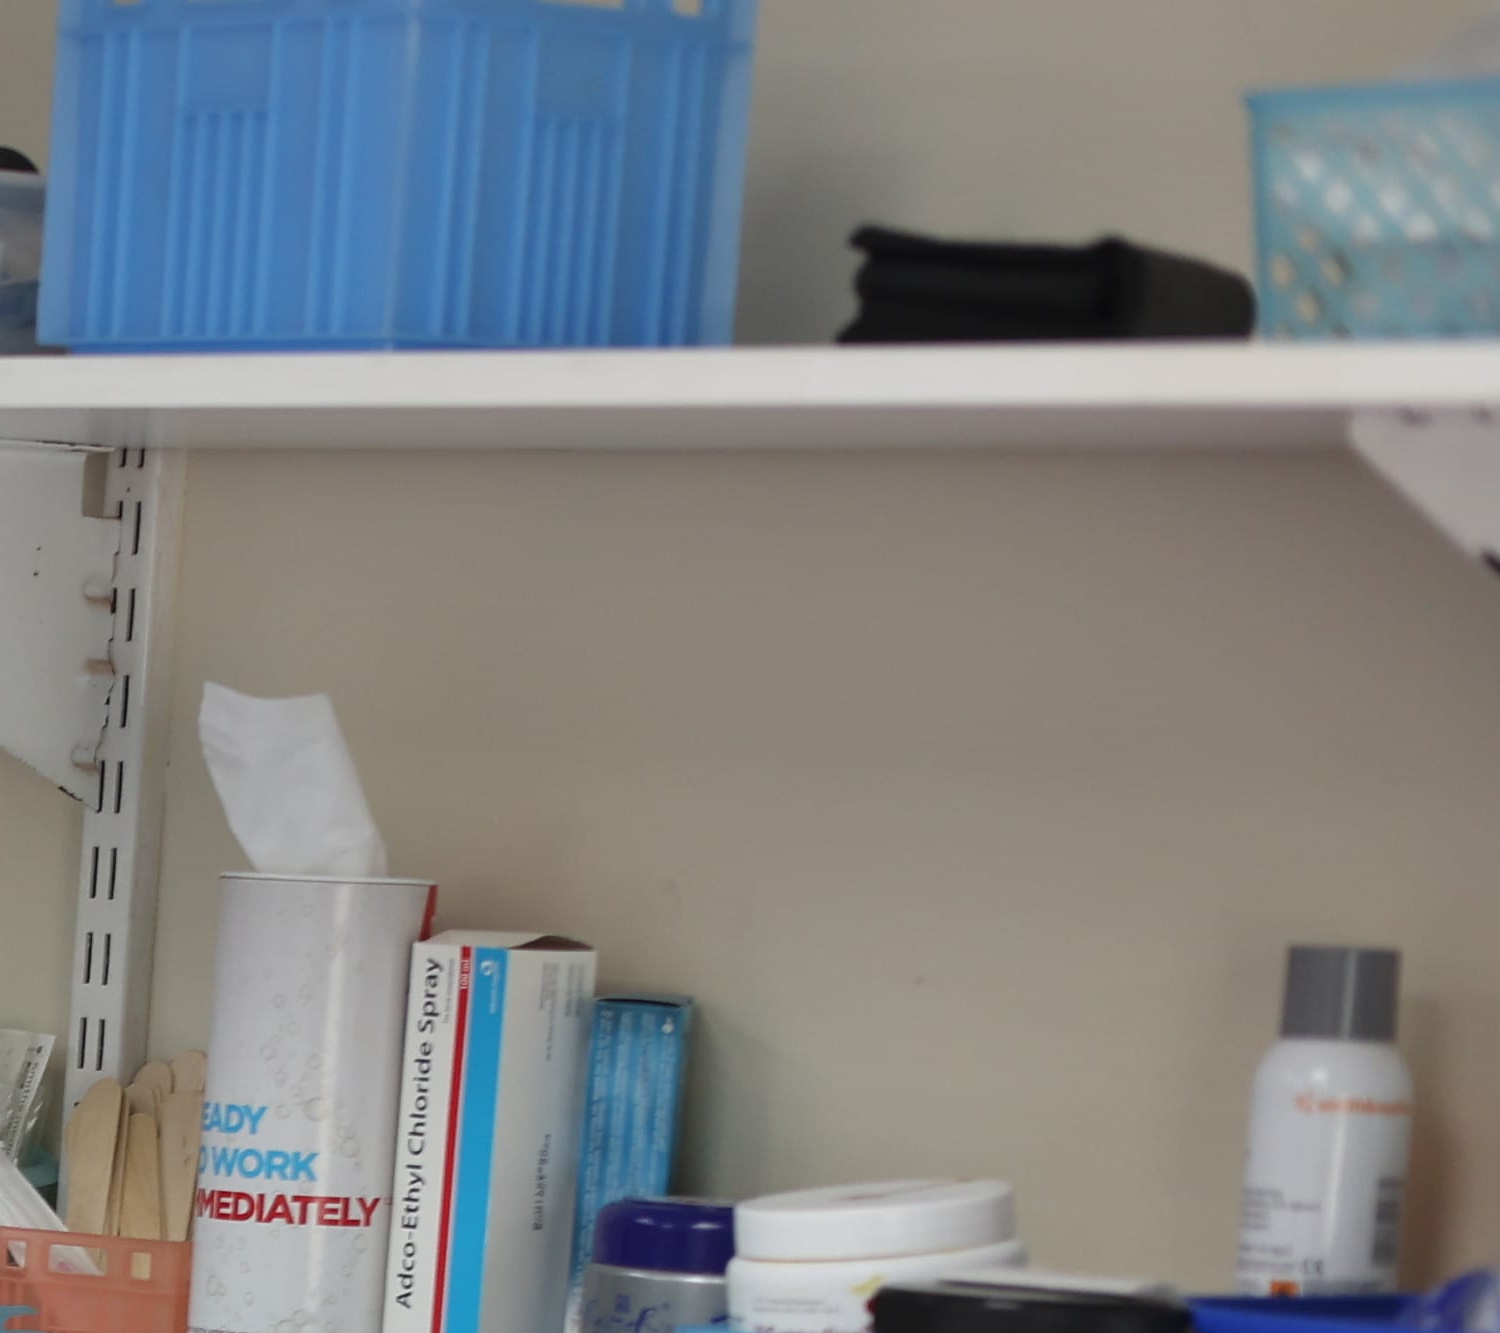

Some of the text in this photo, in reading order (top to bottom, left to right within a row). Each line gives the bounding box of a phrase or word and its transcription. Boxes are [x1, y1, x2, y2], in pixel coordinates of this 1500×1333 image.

[212, 1147, 318, 1182] WORK
[395, 958, 445, 1308] Adco-Ethyl Chloride Spray
